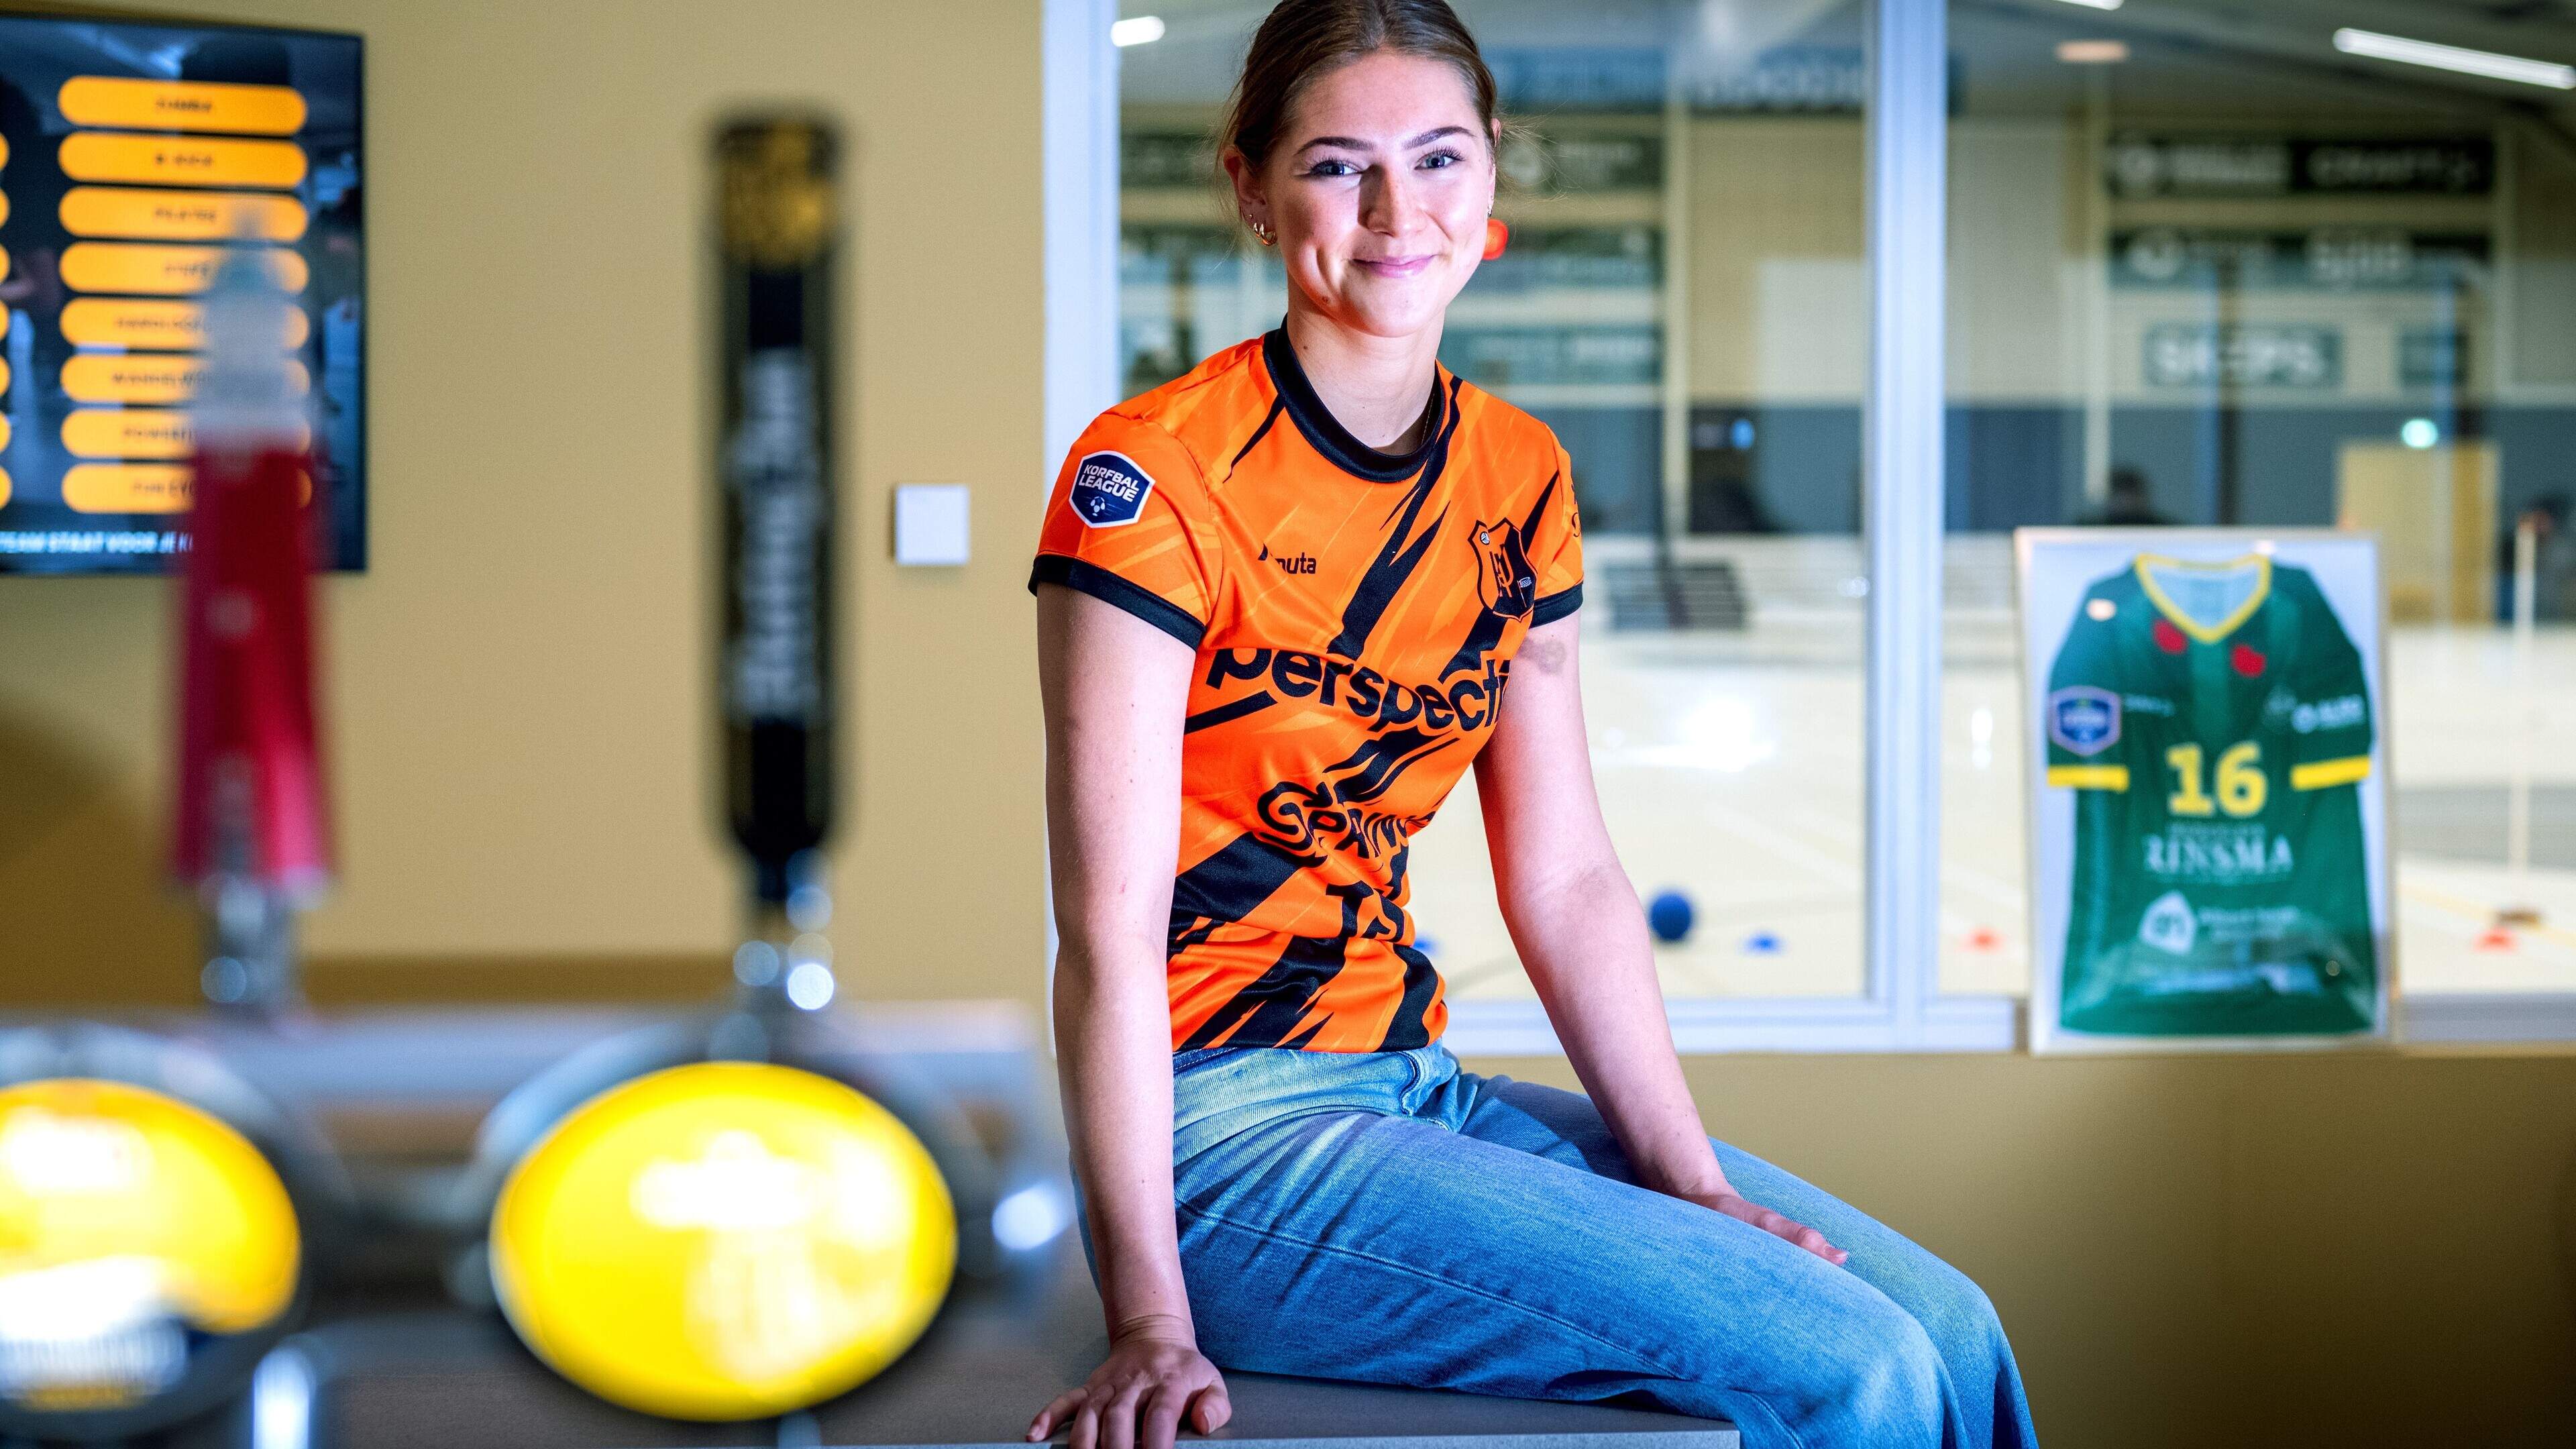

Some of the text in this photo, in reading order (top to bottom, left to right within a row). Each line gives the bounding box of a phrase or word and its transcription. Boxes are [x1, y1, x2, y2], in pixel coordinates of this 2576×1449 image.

[1078, 474, 1138, 502] LEAGUE
[1083, 464, 1140, 492] KORFBAL
[2166, 741, 2268, 818] 16
